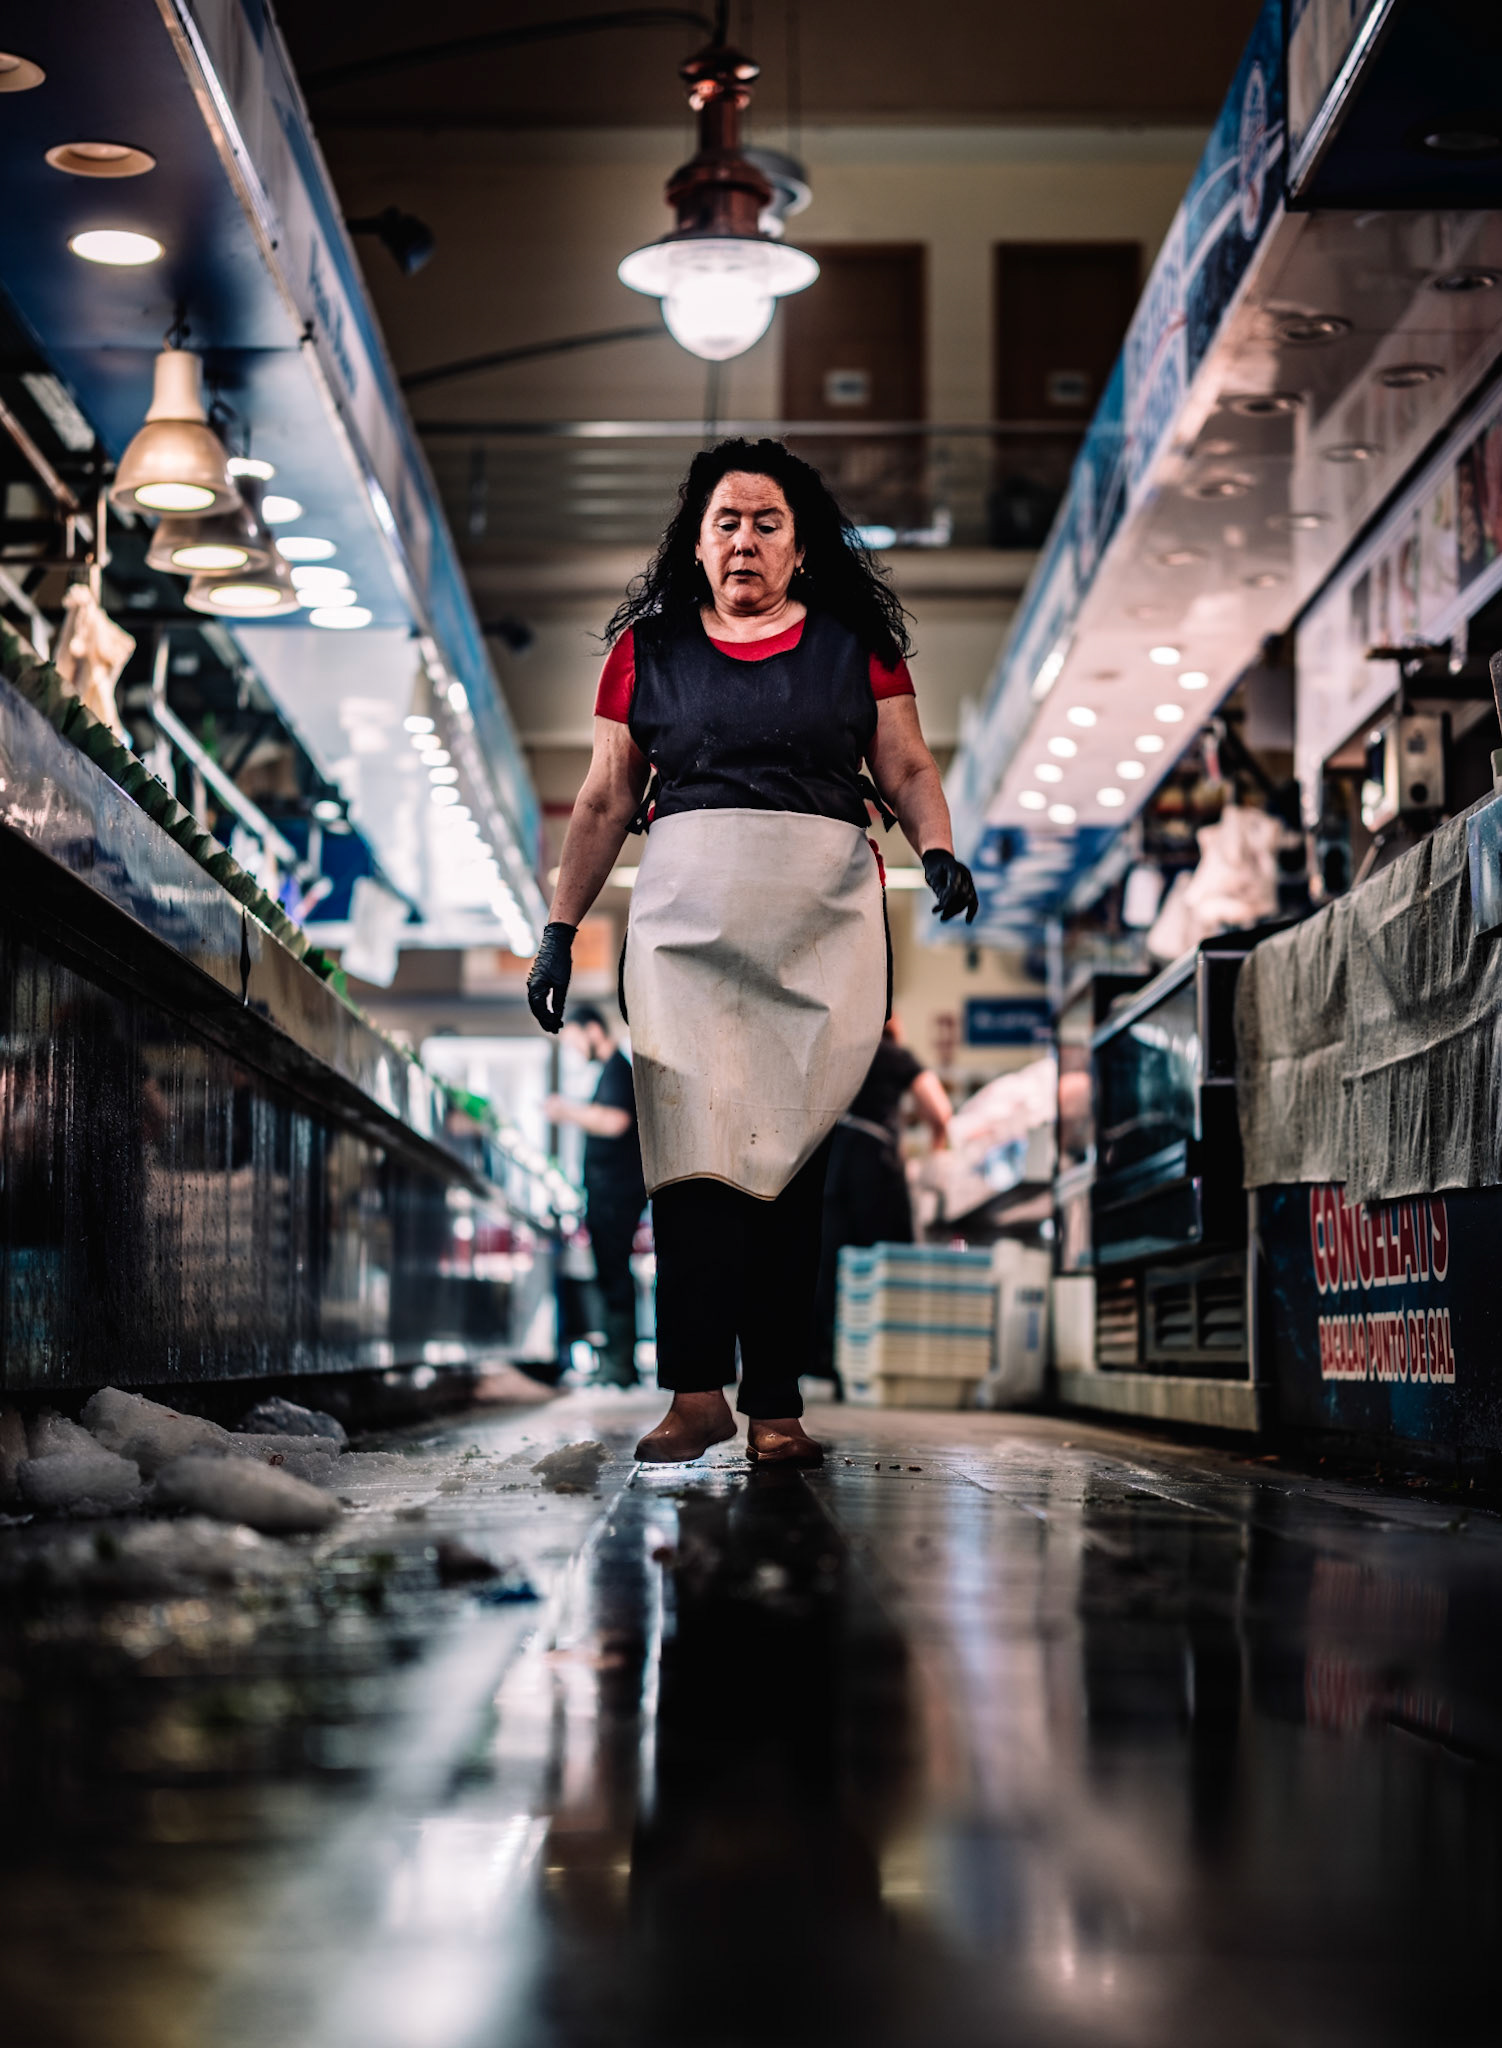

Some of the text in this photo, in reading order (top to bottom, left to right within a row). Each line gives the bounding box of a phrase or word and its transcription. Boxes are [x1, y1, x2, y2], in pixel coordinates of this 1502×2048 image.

[1366, 1310, 1408, 1384] PUNTO
[1407, 1308, 1429, 1384] DE
[1427, 1307, 1456, 1384] SAL
